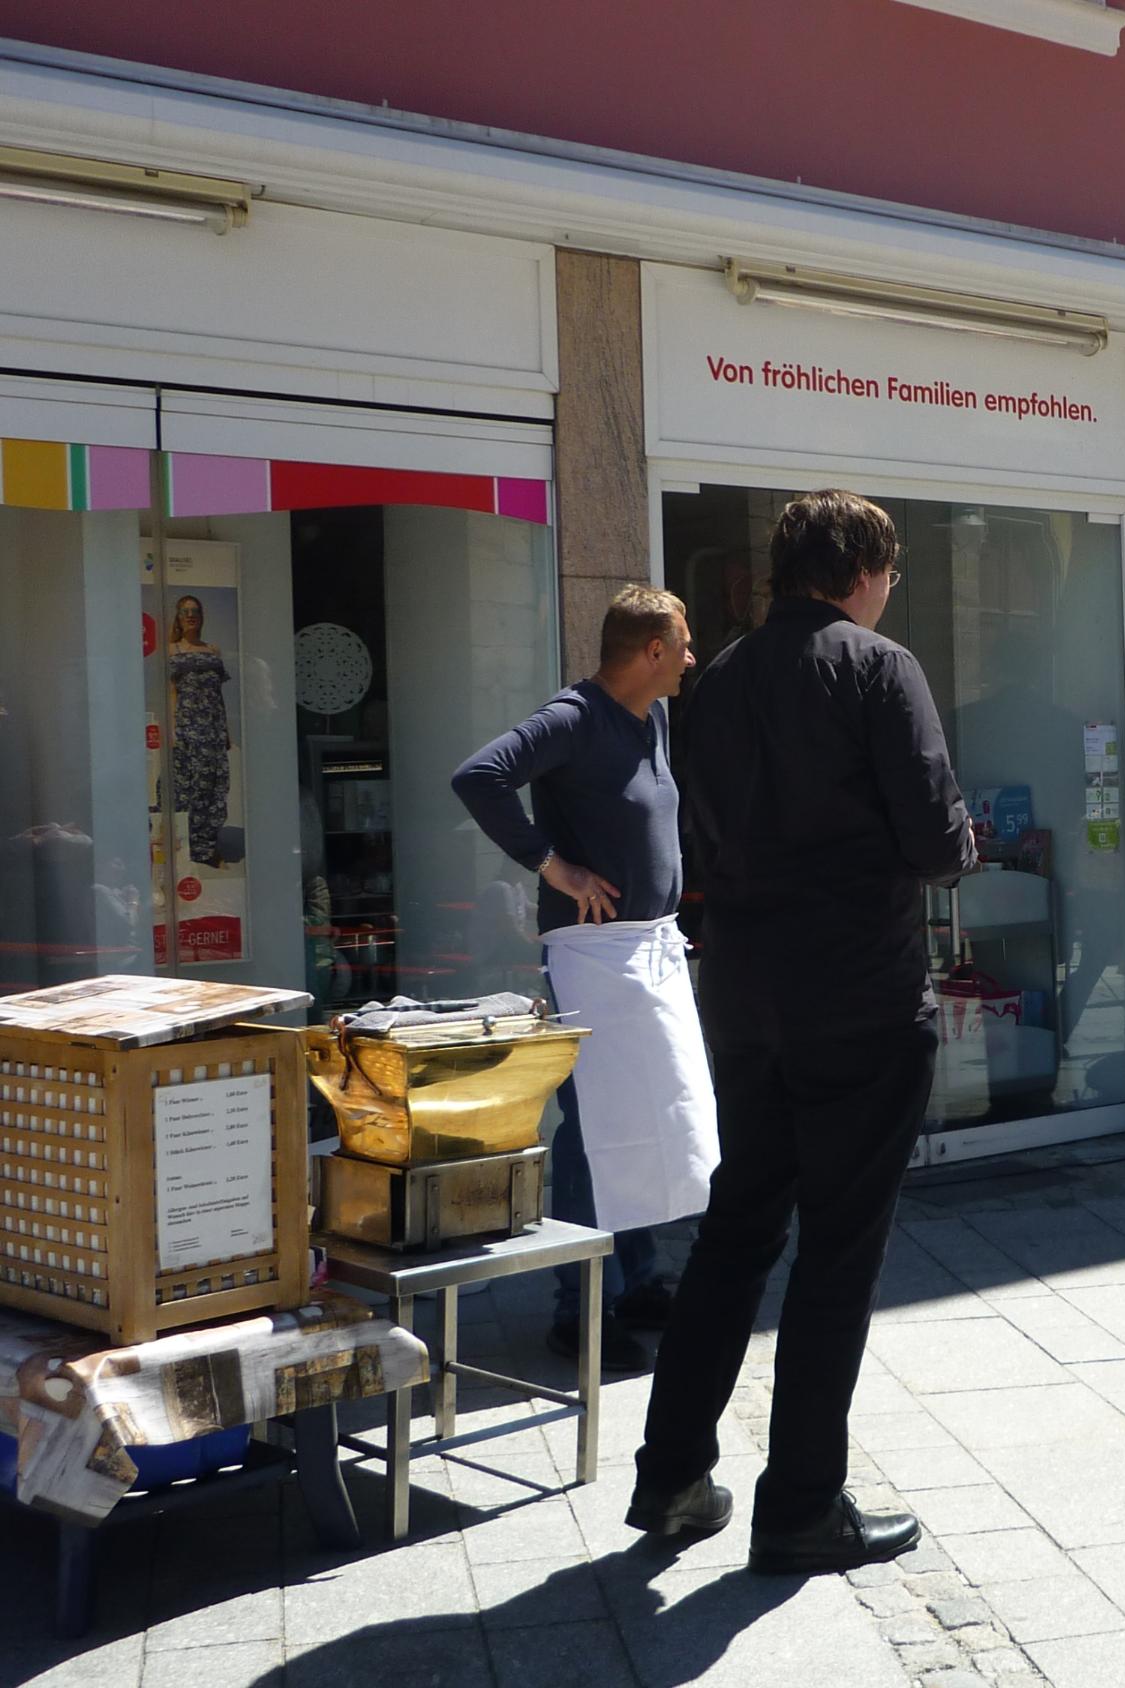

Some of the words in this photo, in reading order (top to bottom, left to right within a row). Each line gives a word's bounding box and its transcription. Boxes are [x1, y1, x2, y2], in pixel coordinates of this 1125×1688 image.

[706, 355, 754, 385] Von
[762, 361, 880, 398] fröhlichen
[887, 376, 978, 409] Familien
[984, 392, 1098, 423] empfohlen.
